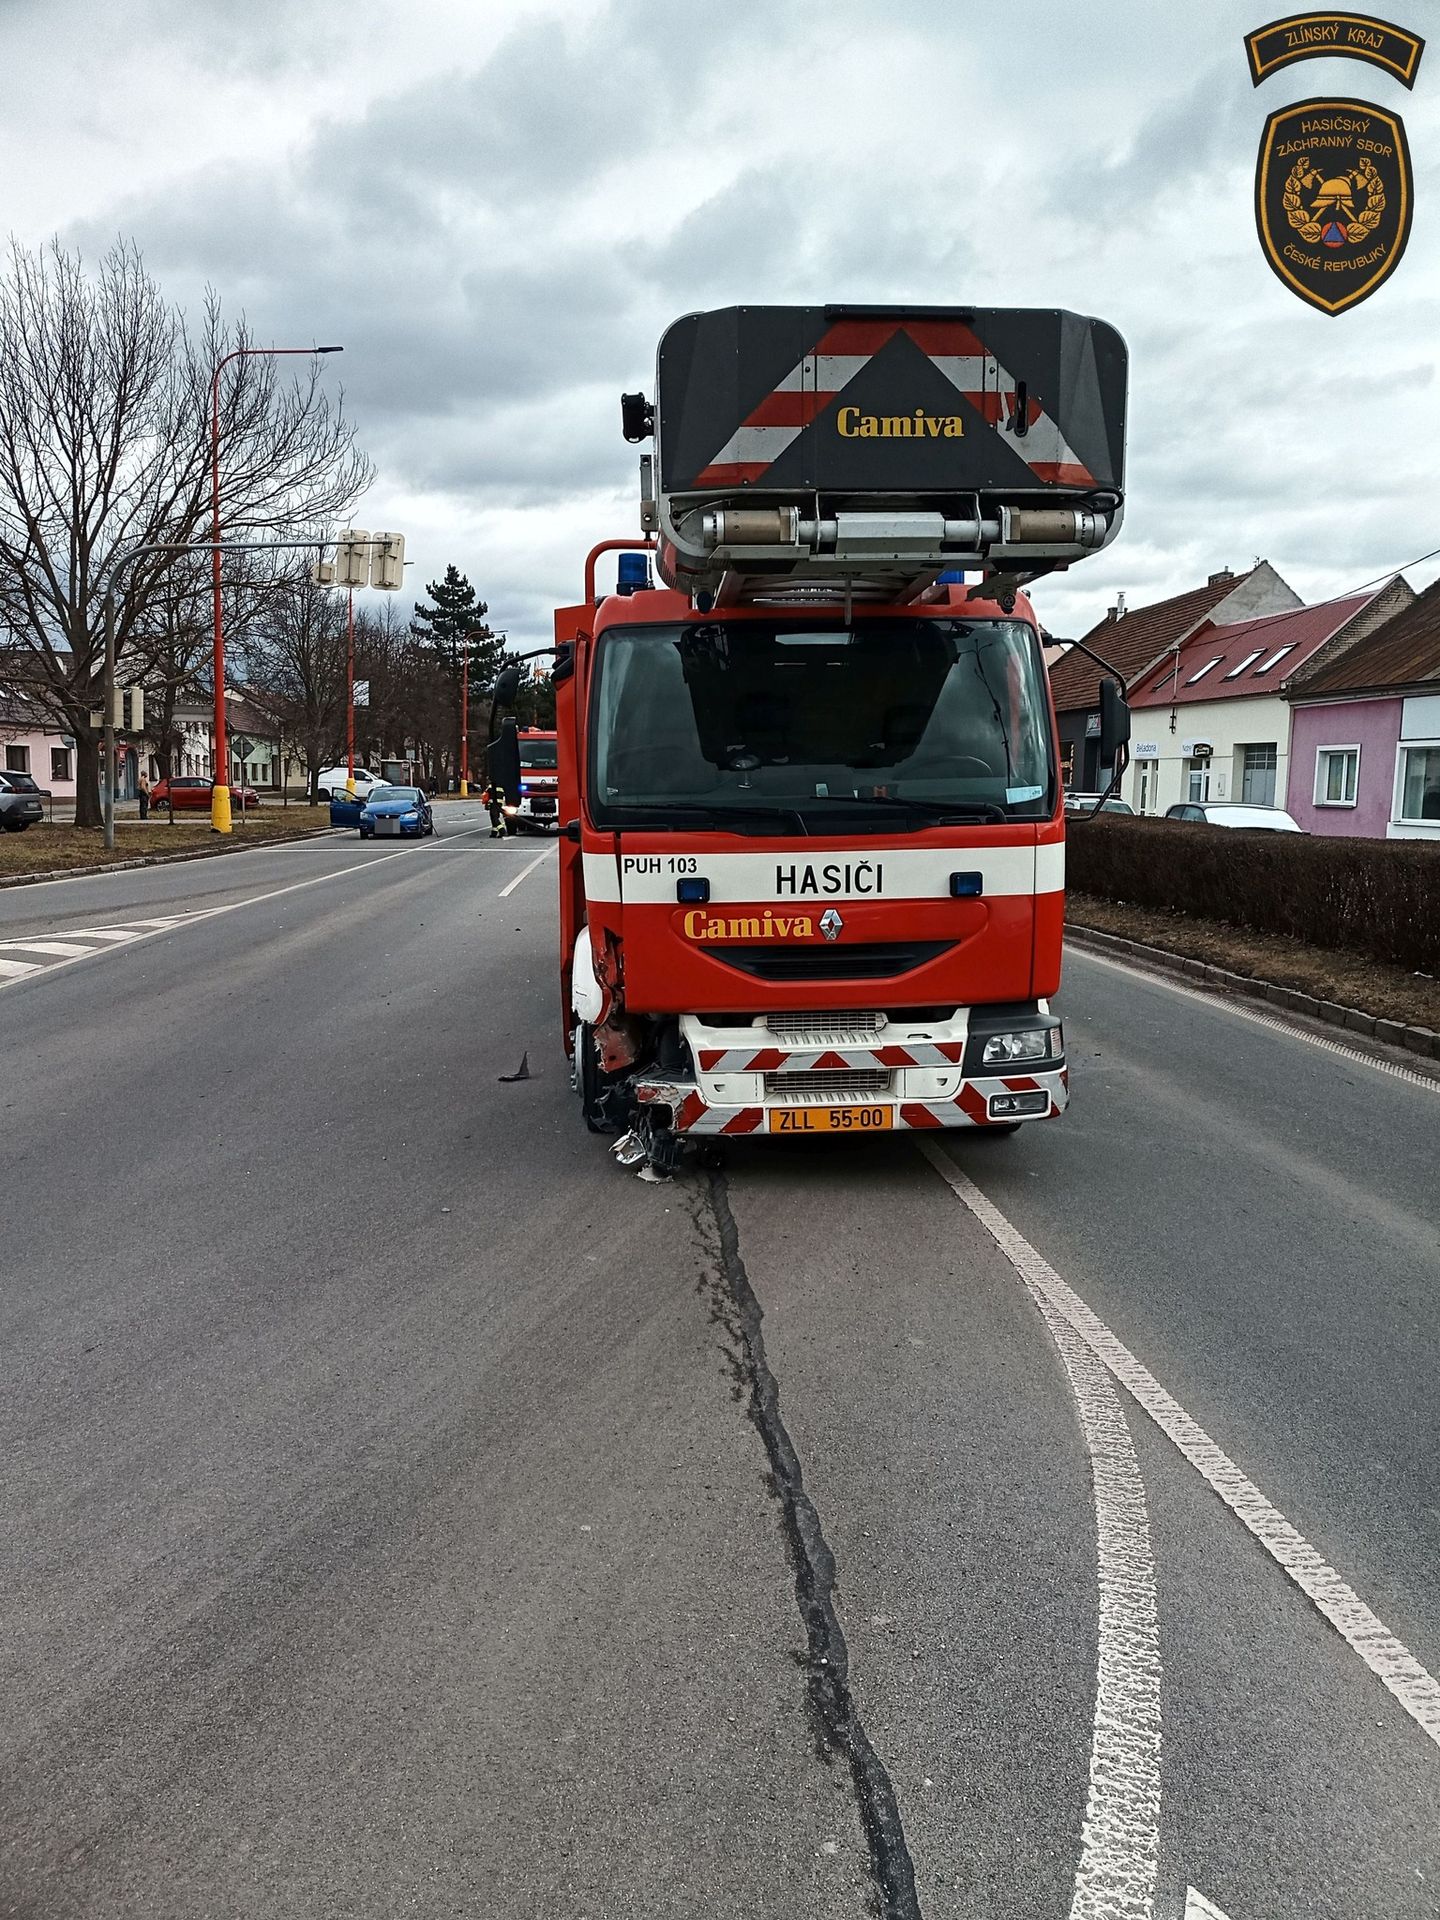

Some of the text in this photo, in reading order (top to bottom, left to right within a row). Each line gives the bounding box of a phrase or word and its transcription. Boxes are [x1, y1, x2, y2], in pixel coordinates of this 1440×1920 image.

[837, 406, 965, 438] Camiva
[624, 857, 697, 874] PUH 103
[776, 860, 883, 895] HASIČI
[684, 910, 814, 940] Camiva
[779, 1108, 883, 1130] ZLL 55-00
